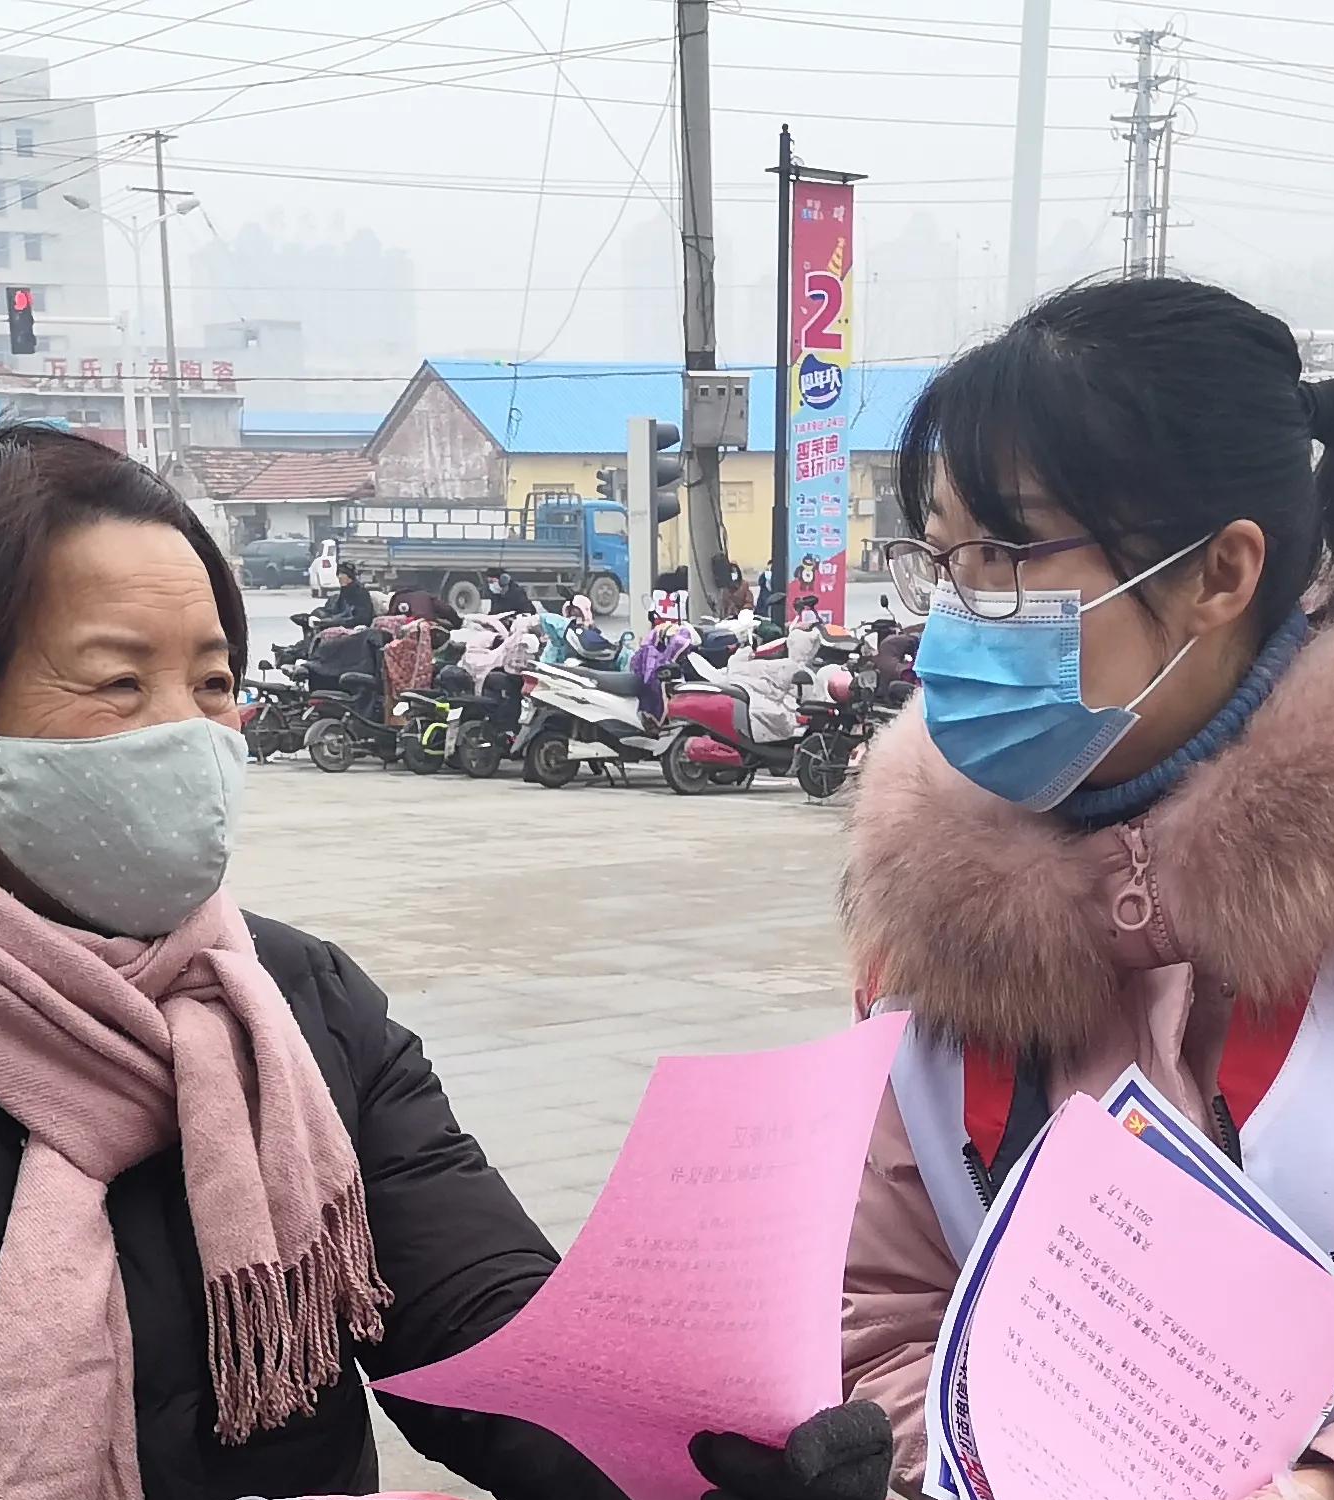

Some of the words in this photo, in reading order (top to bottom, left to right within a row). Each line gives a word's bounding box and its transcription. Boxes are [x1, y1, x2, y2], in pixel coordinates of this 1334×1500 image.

[801, 270, 844, 352] 2
[1089, 1192, 1154, 1253] 灵璧县红十字会
